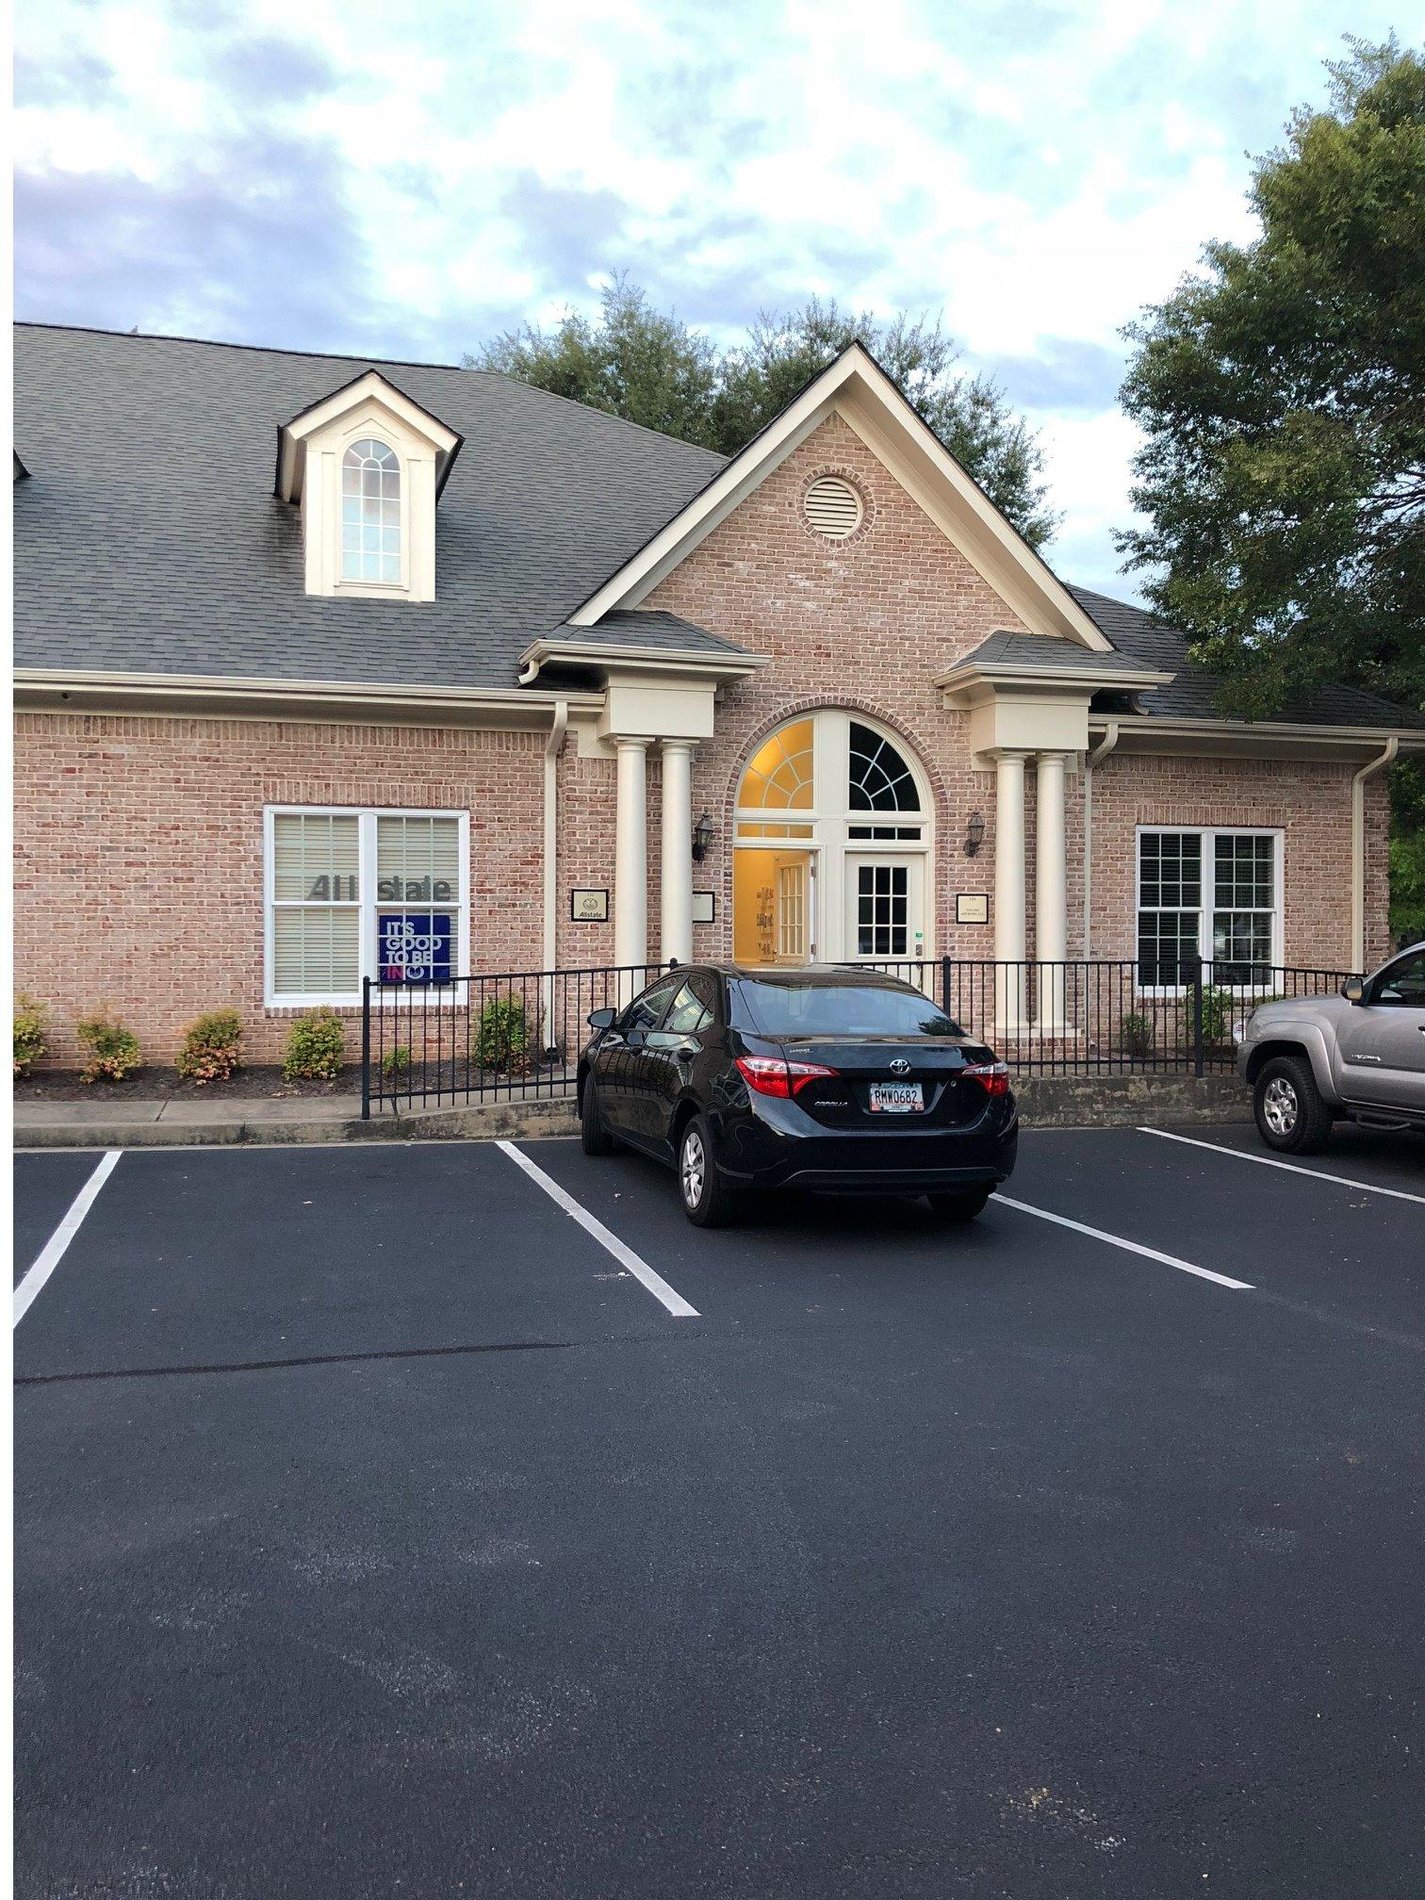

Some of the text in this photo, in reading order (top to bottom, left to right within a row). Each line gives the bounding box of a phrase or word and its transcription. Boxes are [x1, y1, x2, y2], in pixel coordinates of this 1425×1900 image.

[386, 936, 442, 951] GOOD
[385, 950, 431, 965] TO BE
[386, 965, 404, 980] IN
[874, 1089, 918, 1104] RMW0682
